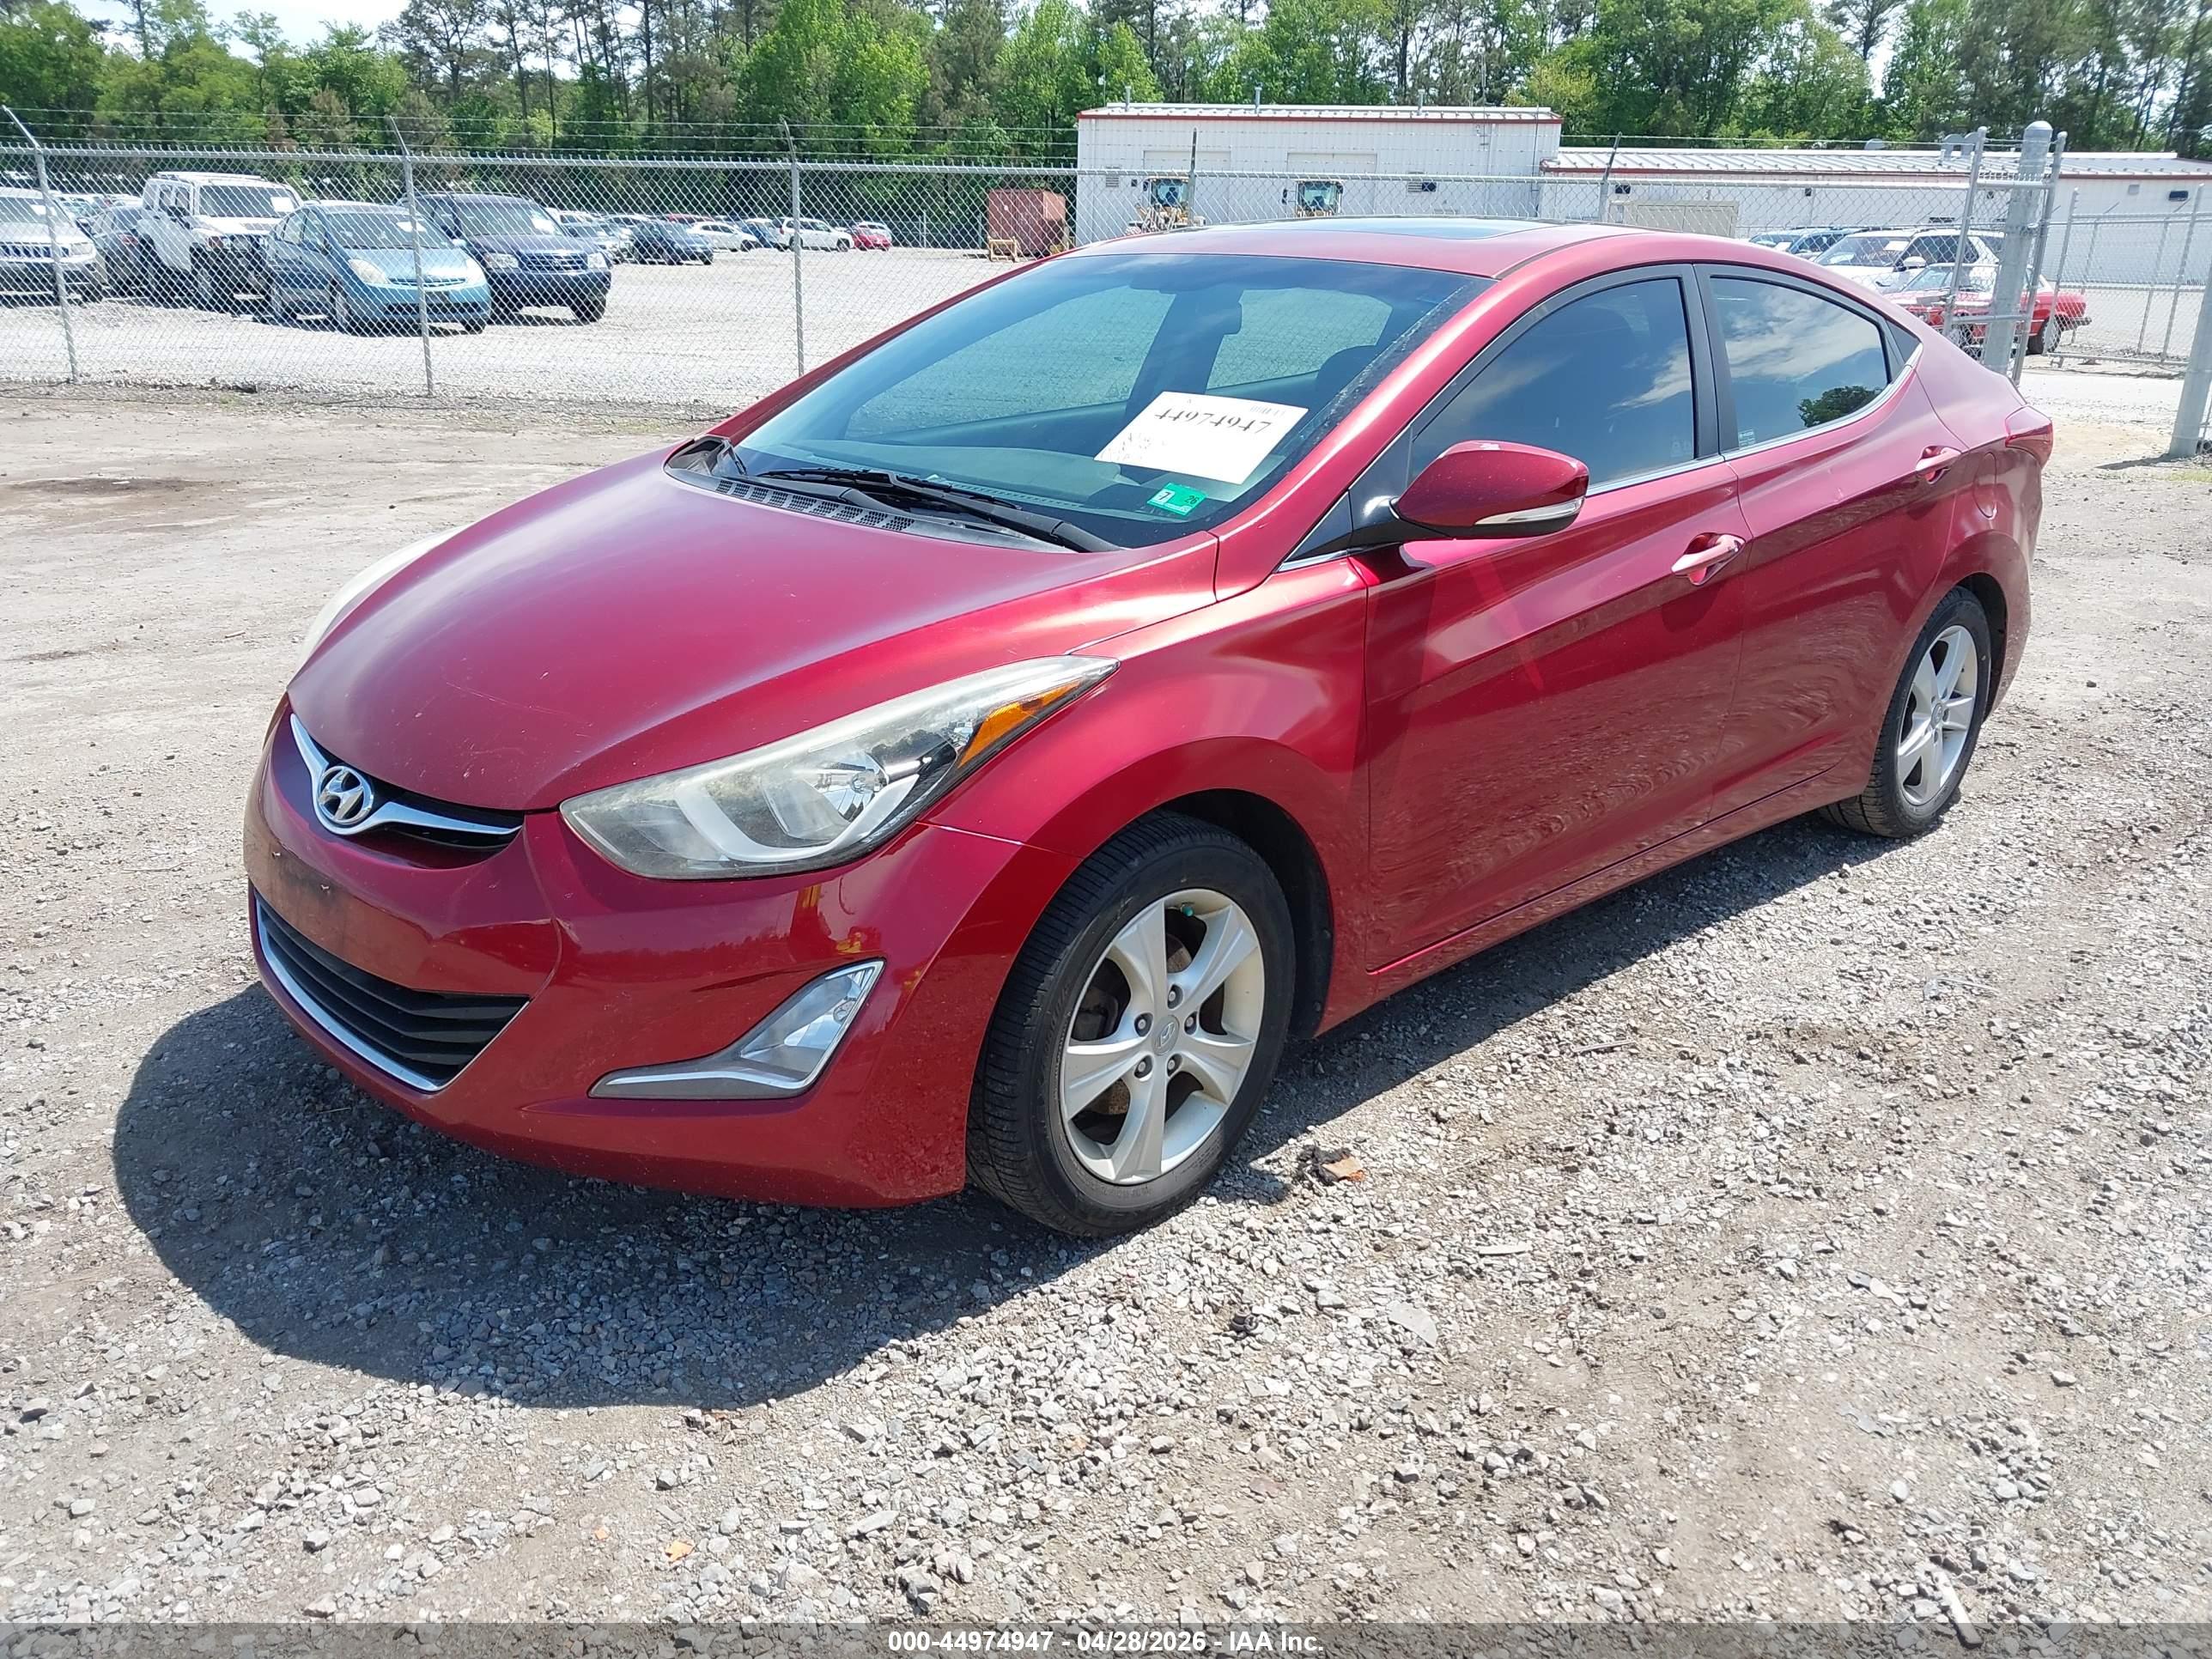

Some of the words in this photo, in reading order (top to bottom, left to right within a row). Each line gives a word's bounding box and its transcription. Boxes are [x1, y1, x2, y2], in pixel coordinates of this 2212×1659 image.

[1154, 408, 1273, 434] 44974947
[1157, 491, 1172, 501] 7
[1184, 495, 1200, 505] 26
